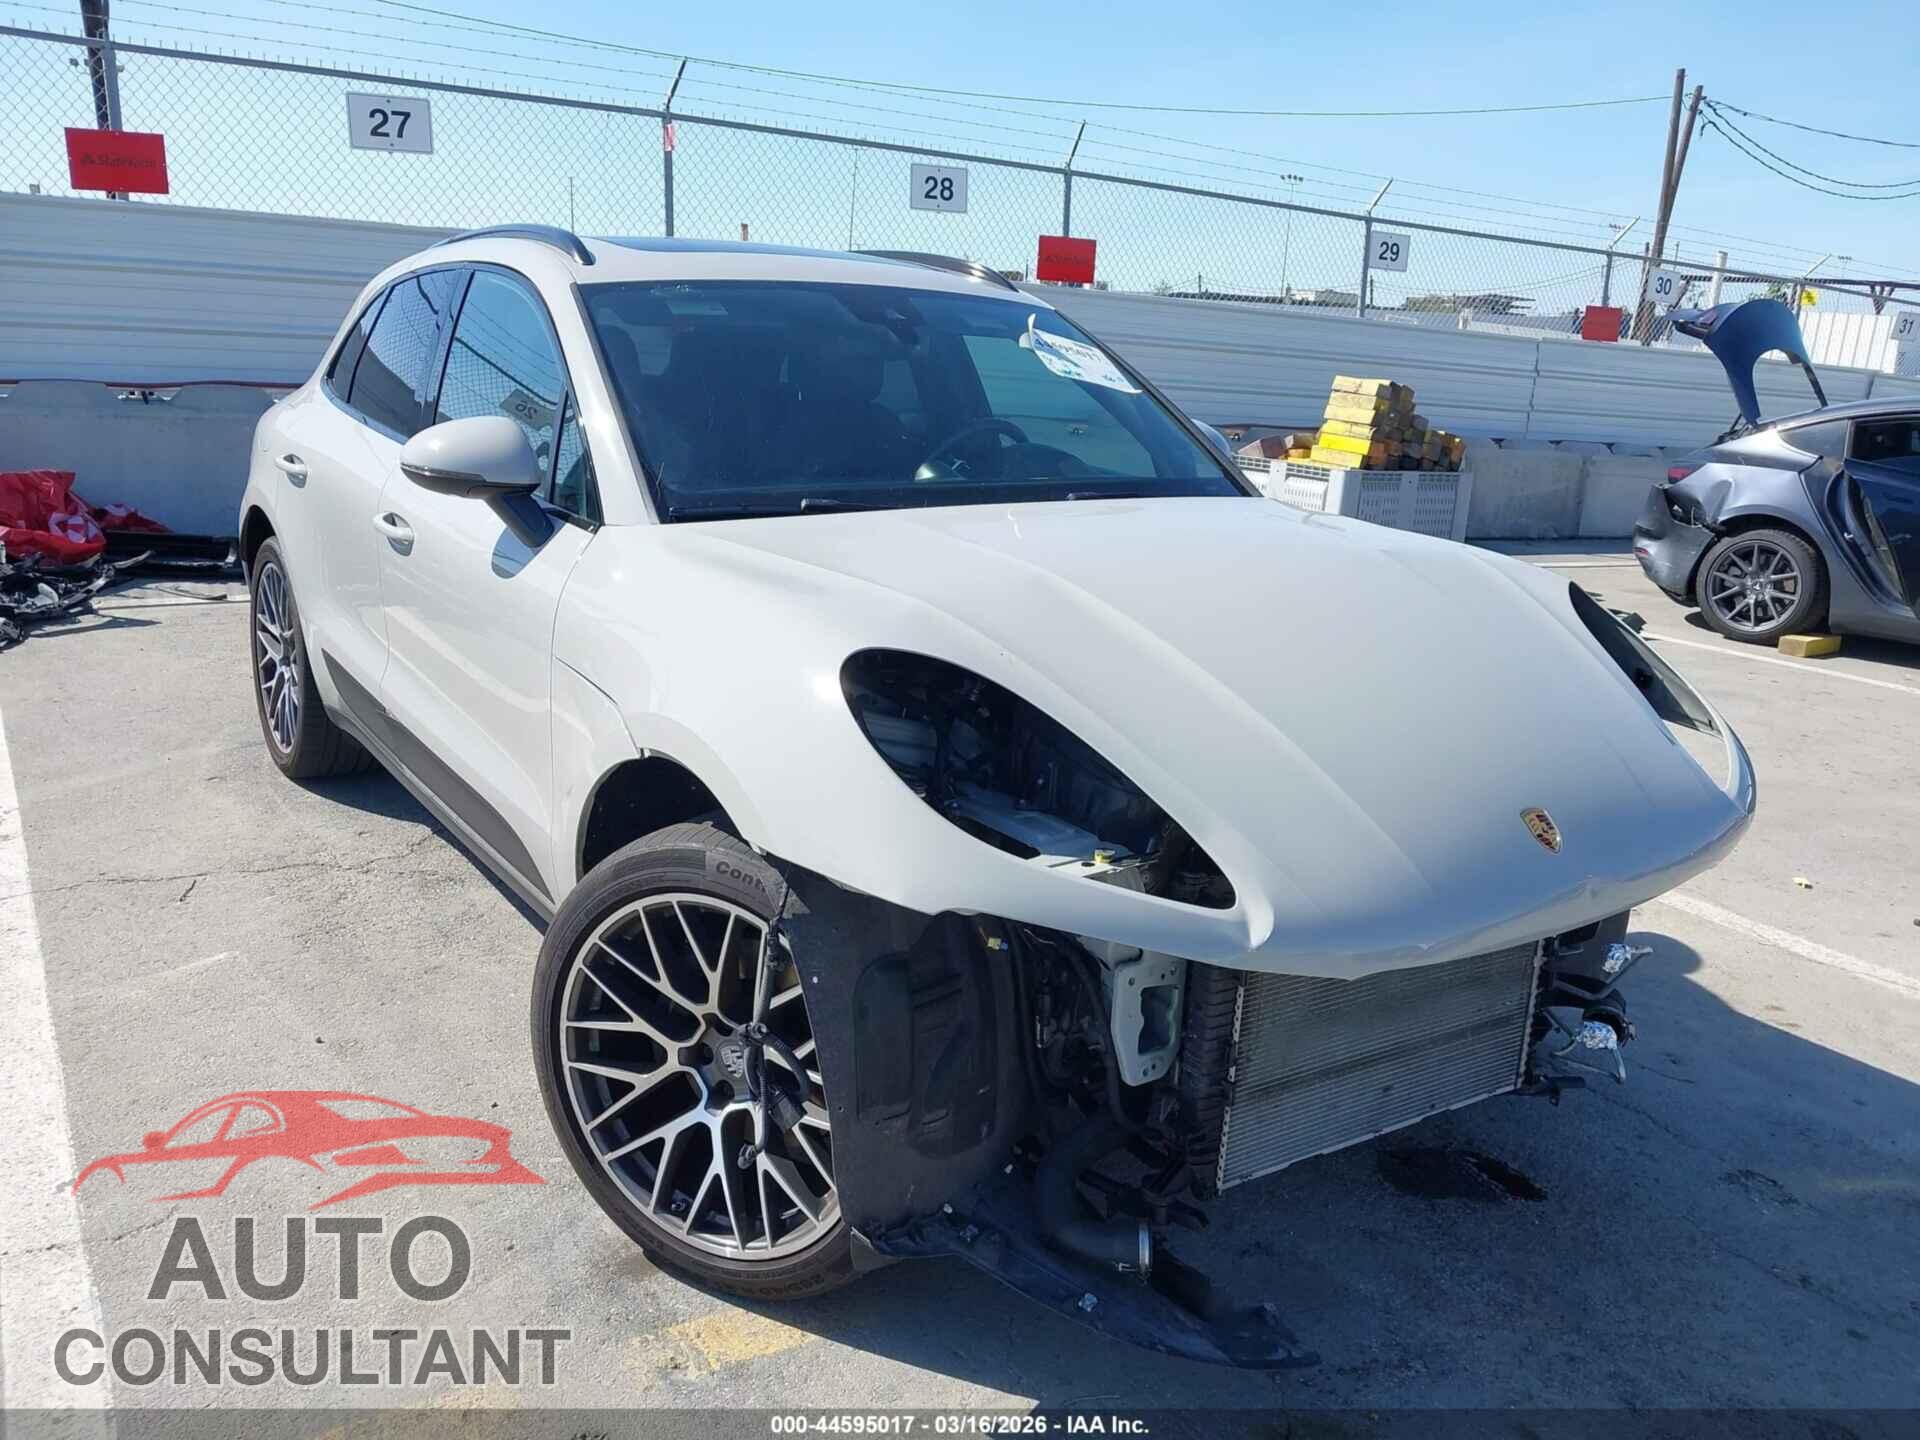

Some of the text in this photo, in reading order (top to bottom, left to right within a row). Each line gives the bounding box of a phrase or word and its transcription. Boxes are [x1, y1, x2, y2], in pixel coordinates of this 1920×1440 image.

[368, 107, 411, 139] 27
[923, 175, 954, 201] 28
[1378, 241, 1401, 262] 29
[1655, 276, 1673, 296] 30
[1899, 318, 1914, 335] 31
